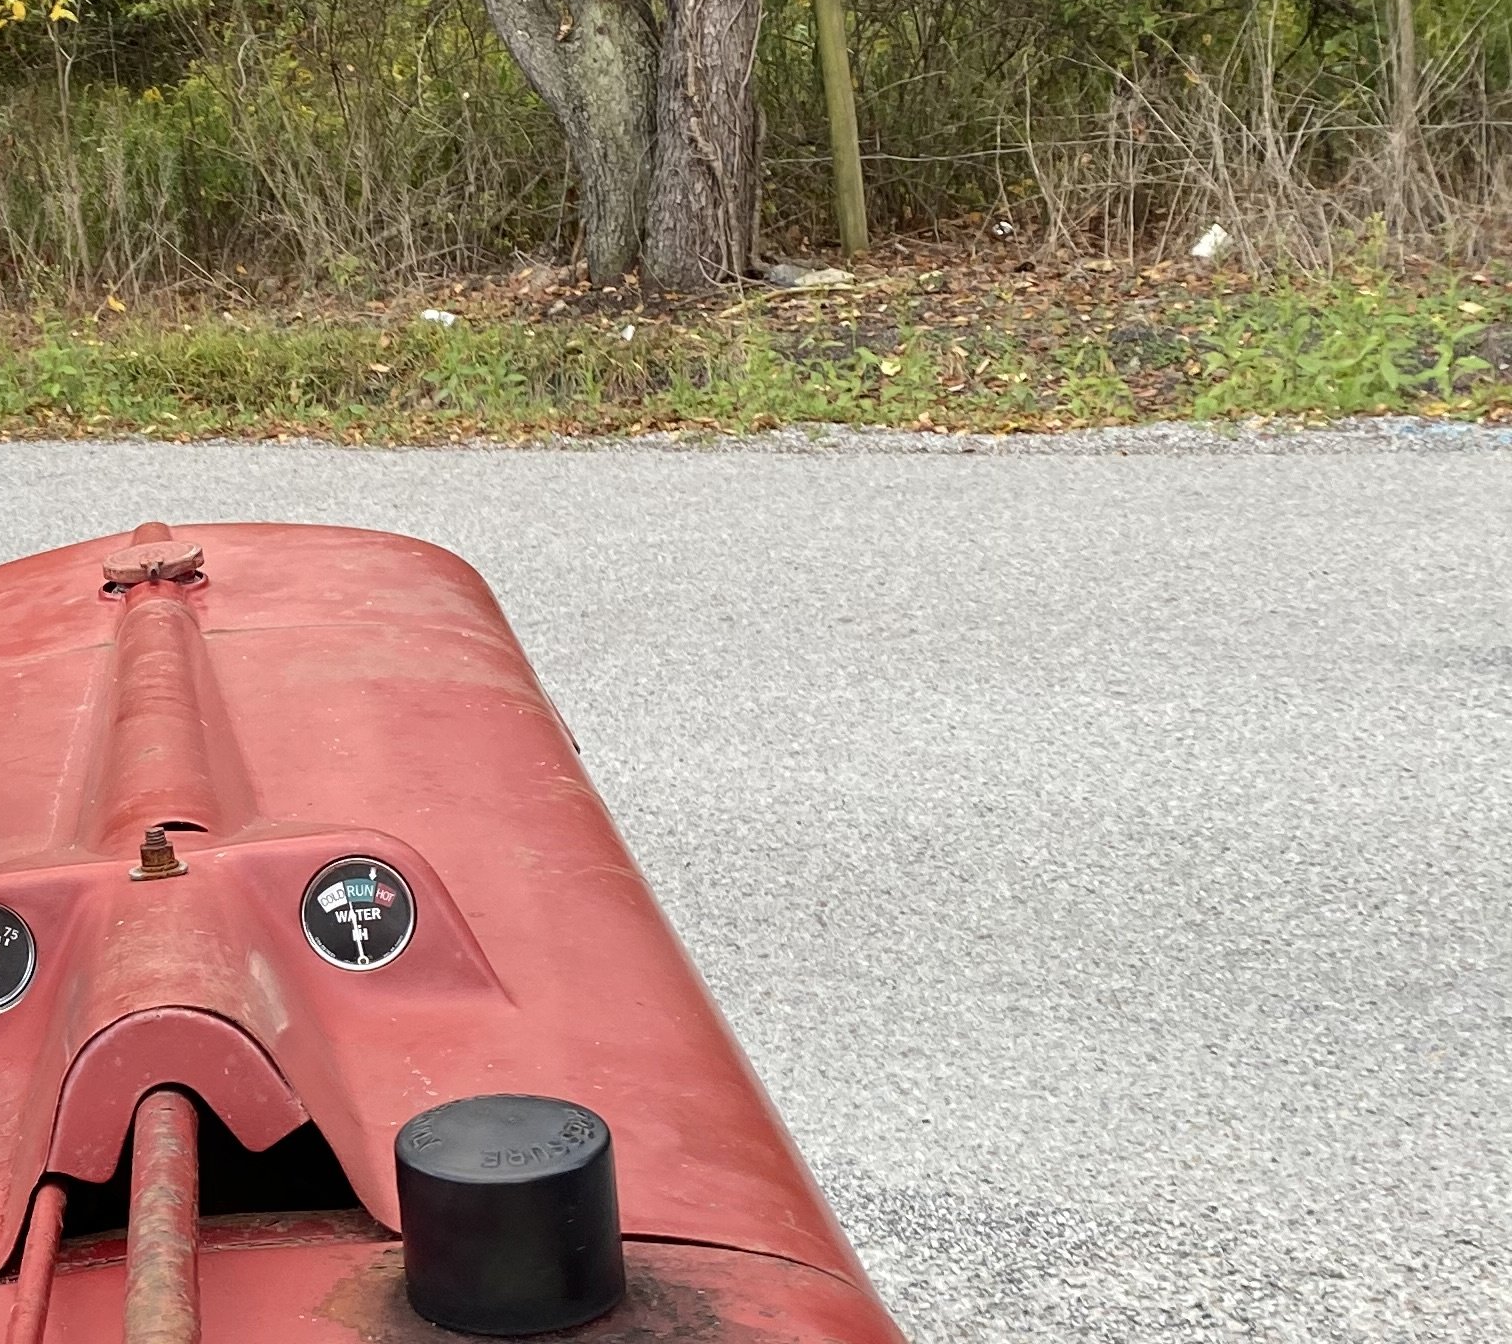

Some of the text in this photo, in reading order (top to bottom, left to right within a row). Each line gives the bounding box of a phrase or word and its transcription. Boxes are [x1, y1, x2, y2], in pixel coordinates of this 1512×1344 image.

[320, 889, 345, 907] COLD
[348, 885, 374, 897] RUN
[376, 888, 395, 902] HOT
[335, 908, 381, 923] WATER
[3, 927, 19, 940] 75
